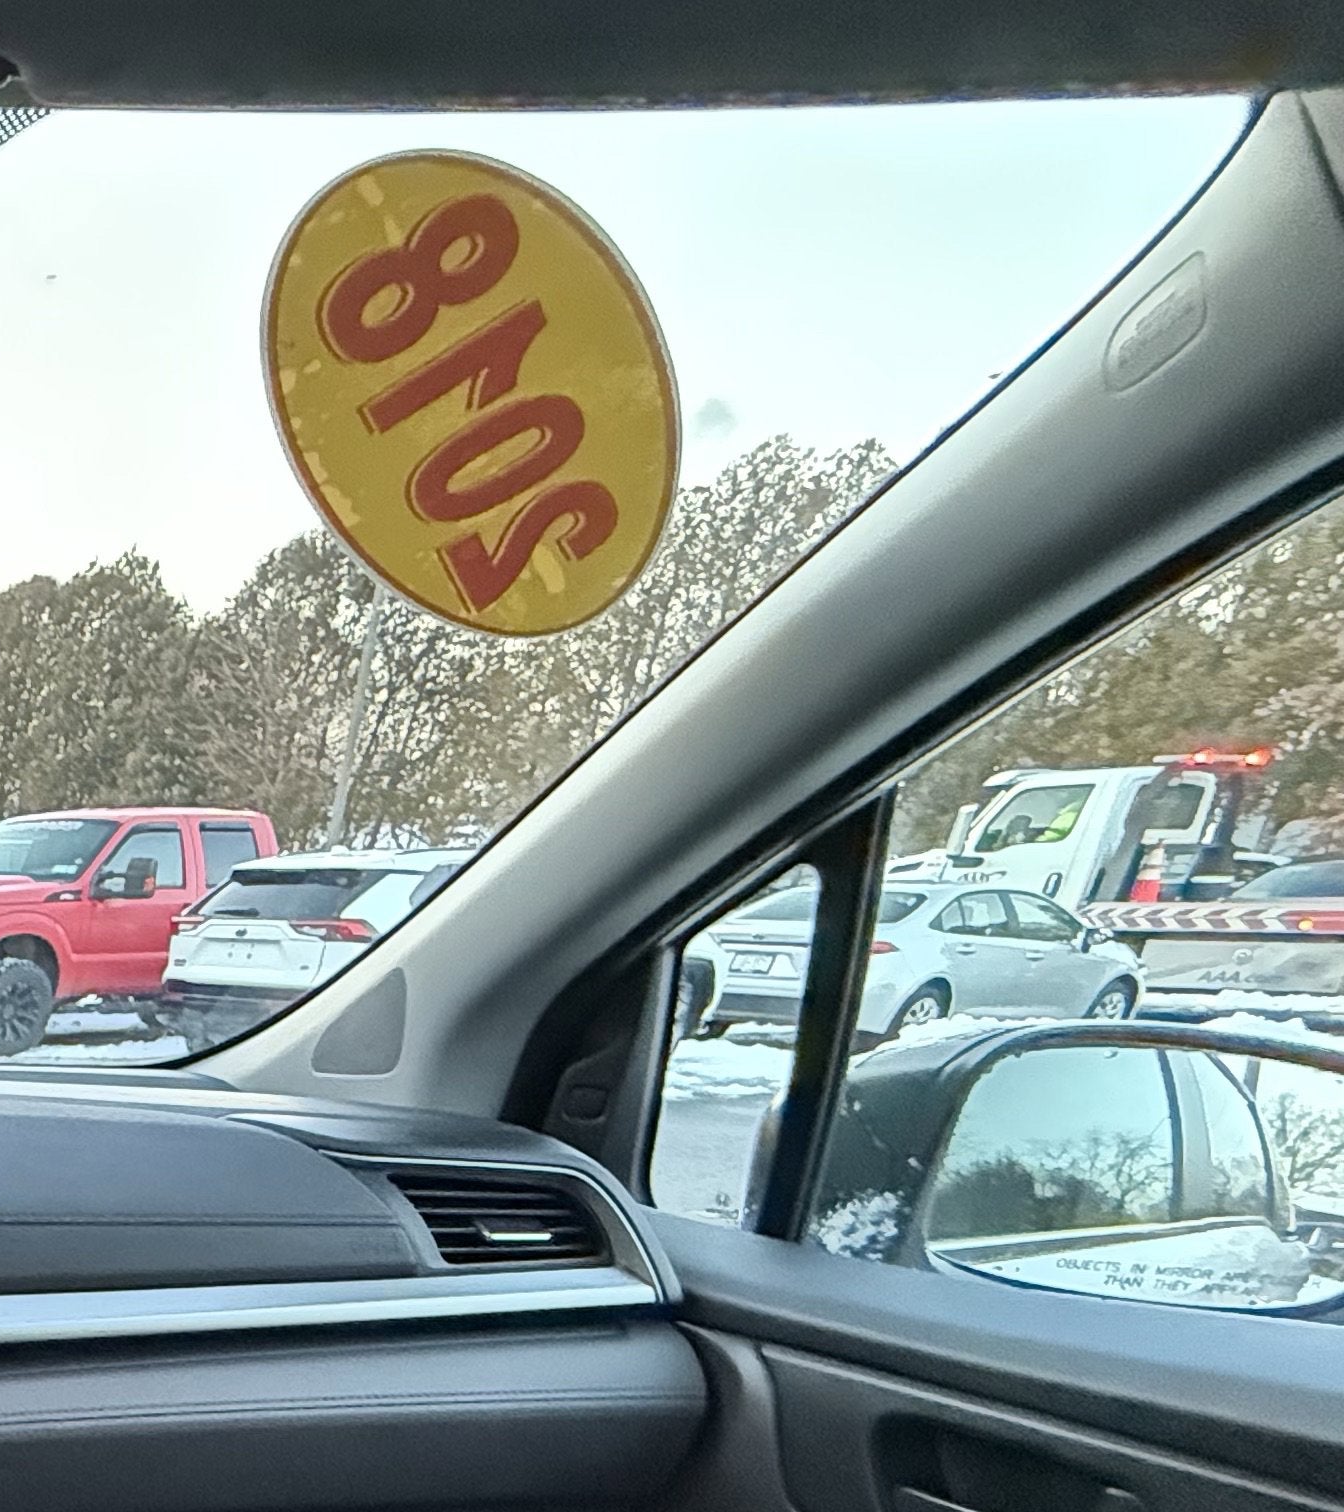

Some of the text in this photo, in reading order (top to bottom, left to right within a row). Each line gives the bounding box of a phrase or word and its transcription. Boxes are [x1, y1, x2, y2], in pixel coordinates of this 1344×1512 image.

[1056, 1257, 1122, 1273] OBJECTS
[1129, 1262, 1148, 1275] IN
[1154, 1265, 1215, 1280] MIRROR
